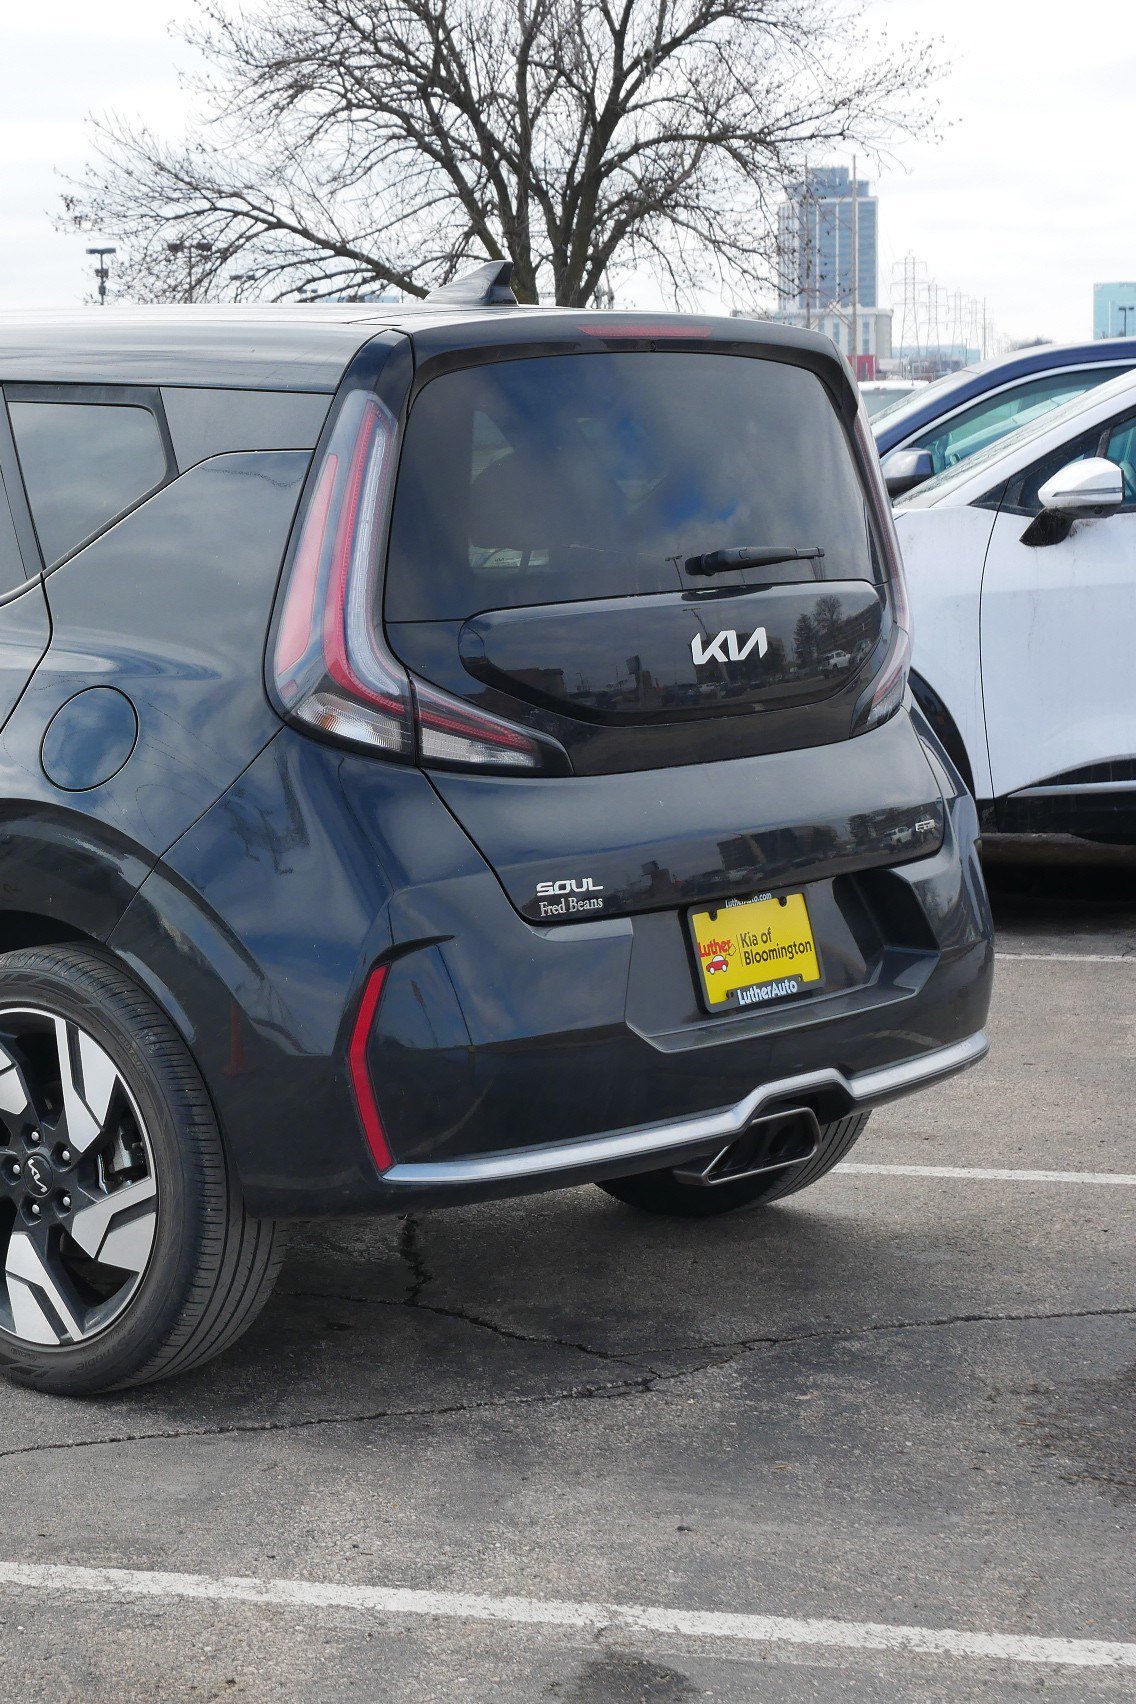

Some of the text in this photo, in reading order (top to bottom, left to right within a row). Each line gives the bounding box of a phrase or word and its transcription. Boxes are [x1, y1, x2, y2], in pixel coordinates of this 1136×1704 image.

[691, 627, 768, 665] KIA
[536, 878, 604, 897] SOUL
[539, 897, 604, 917] Fred Beans
[740, 927, 772, 948] Kia of
[698, 939, 731, 958] Luther
[744, 941, 813, 966] Bloomington
[737, 979, 798, 1005] LutherAuto
